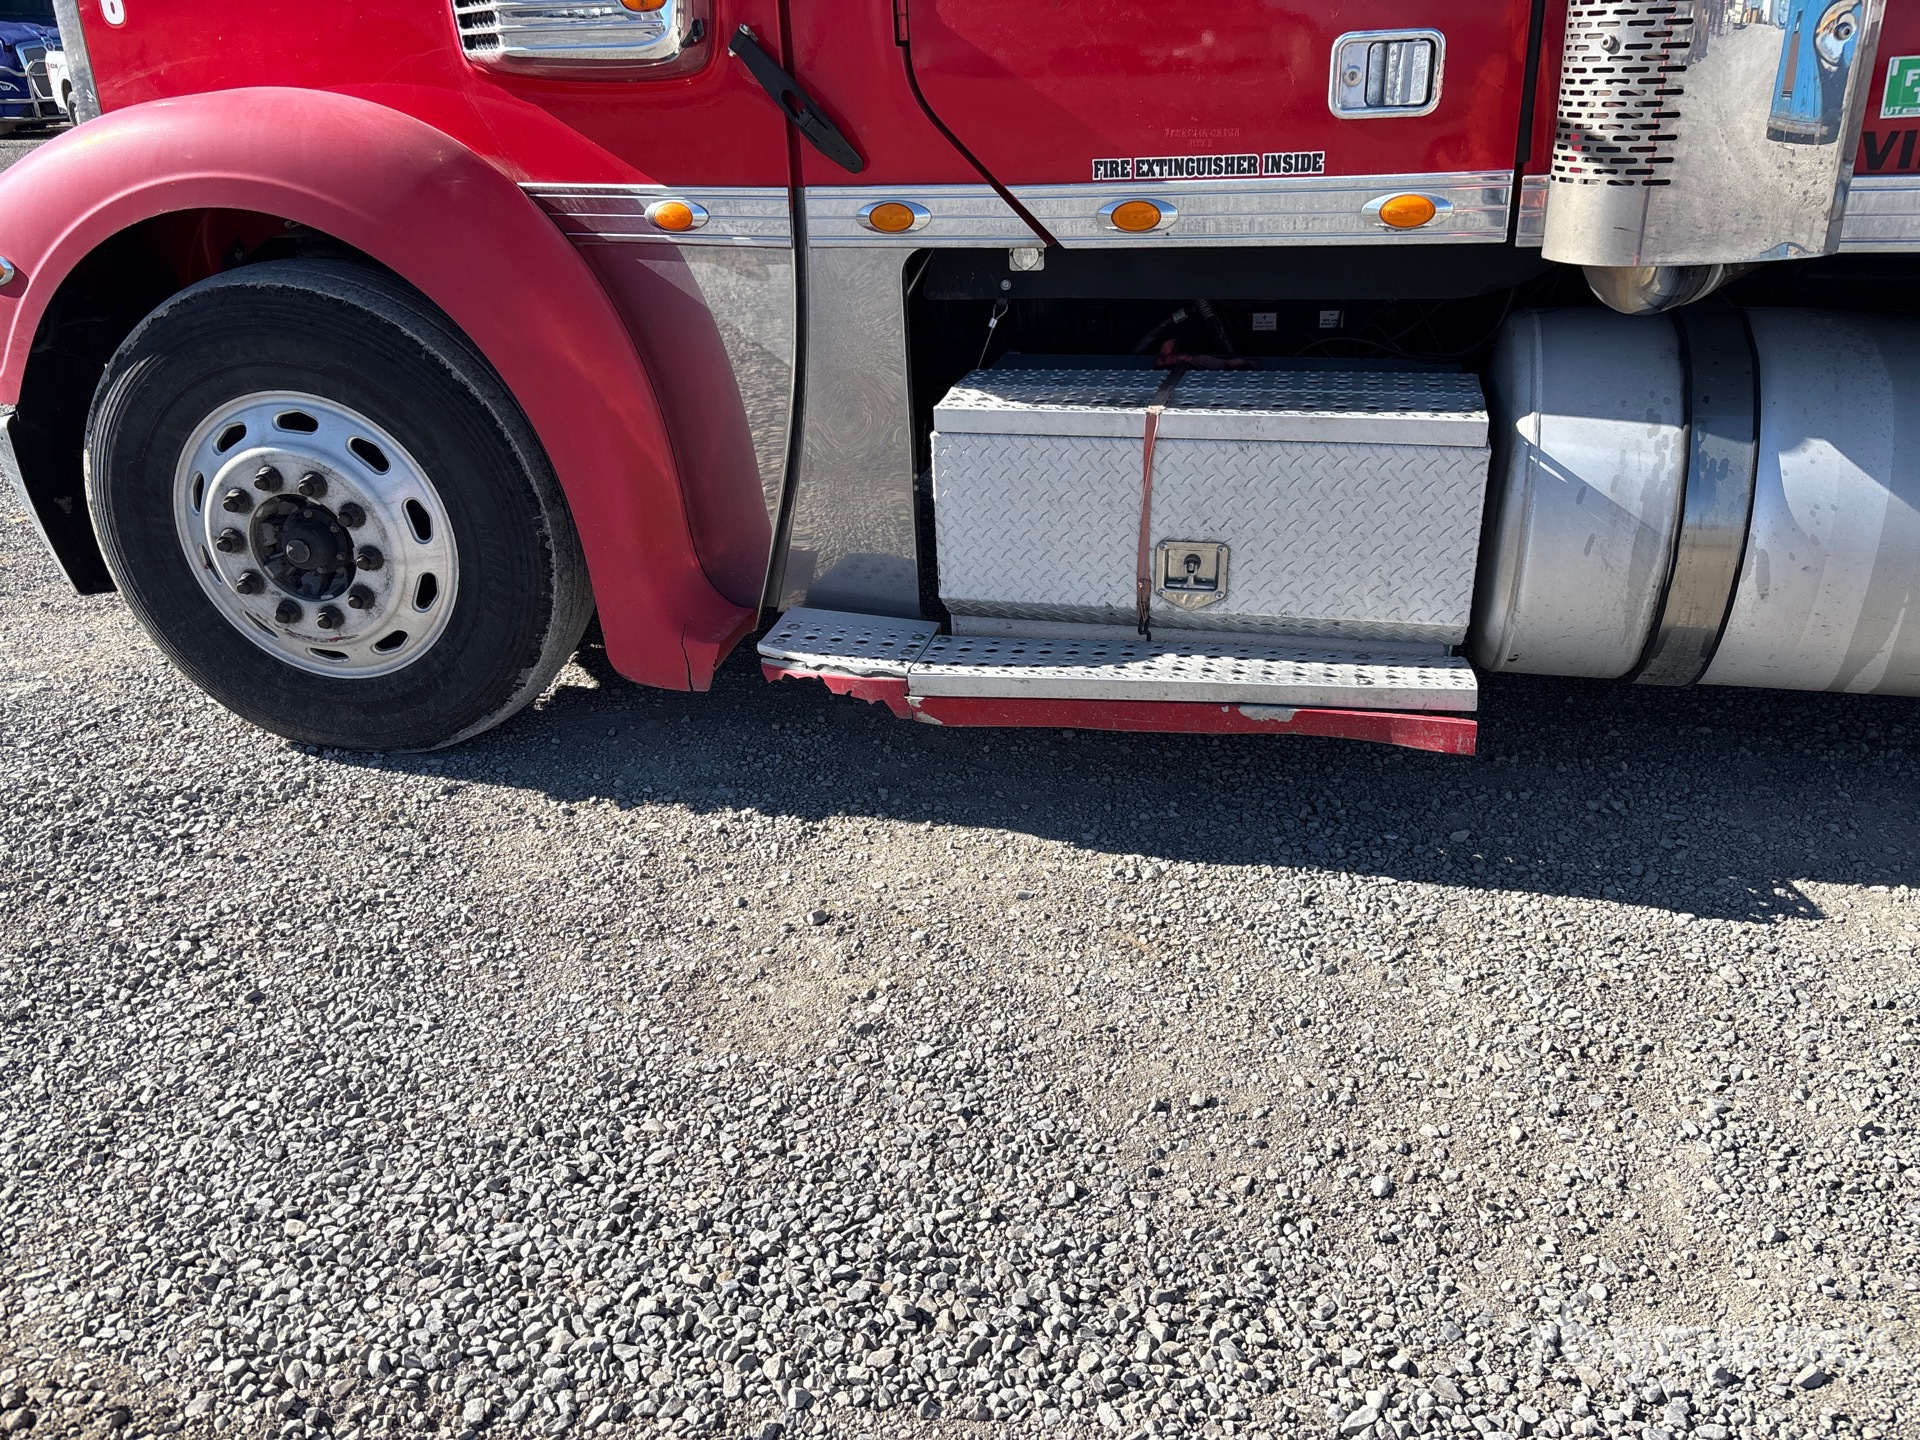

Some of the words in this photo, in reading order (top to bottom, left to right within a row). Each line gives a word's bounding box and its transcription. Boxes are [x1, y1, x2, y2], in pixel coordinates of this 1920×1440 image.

[1093, 158, 1132, 180] FIRE
[1134, 154, 1260, 179] EXTINGUISHER
[1262, 151, 1325, 176] INSIDE
[1862, 130, 1920, 171] VI
